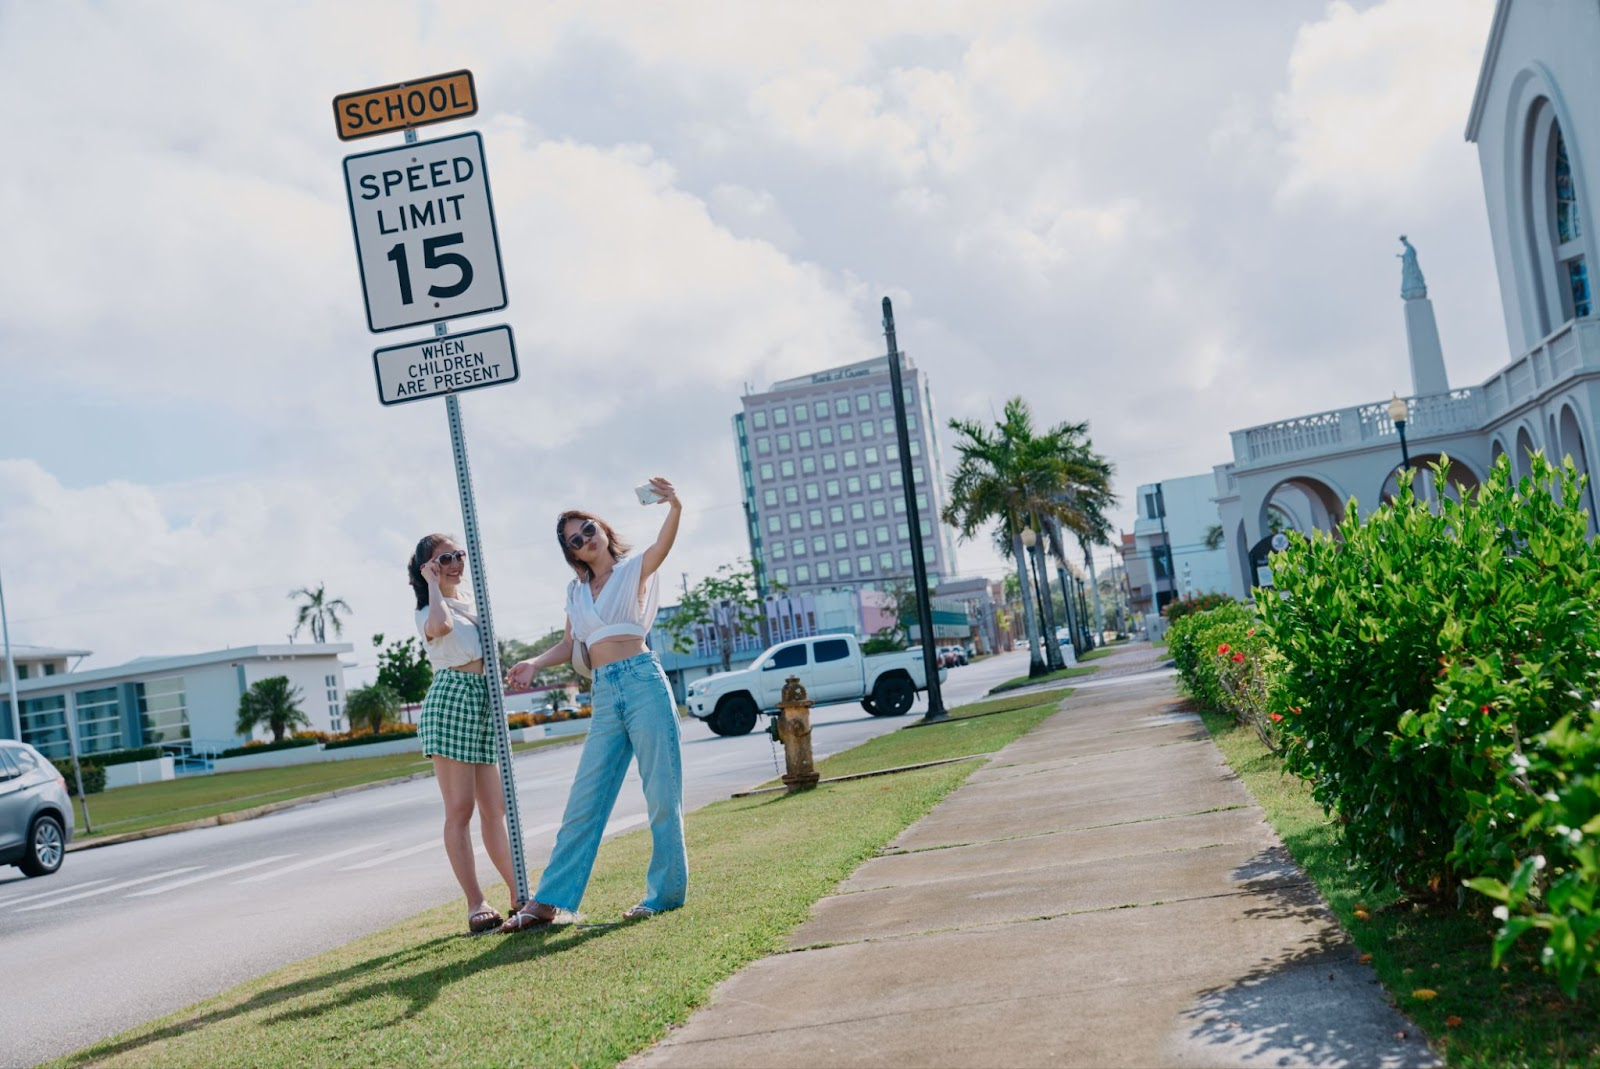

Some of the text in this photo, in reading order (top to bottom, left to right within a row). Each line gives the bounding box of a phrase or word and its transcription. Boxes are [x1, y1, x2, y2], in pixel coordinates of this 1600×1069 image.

[345, 84, 469, 129] SCHOOL
[359, 156, 474, 200] SPEED
[377, 194, 465, 235] LIMIT
[387, 232, 474, 306] 15
[408, 352, 485, 378] CHILDREN
[421, 340, 465, 360] WHEN
[397, 364, 501, 397] ARE PRESENT
